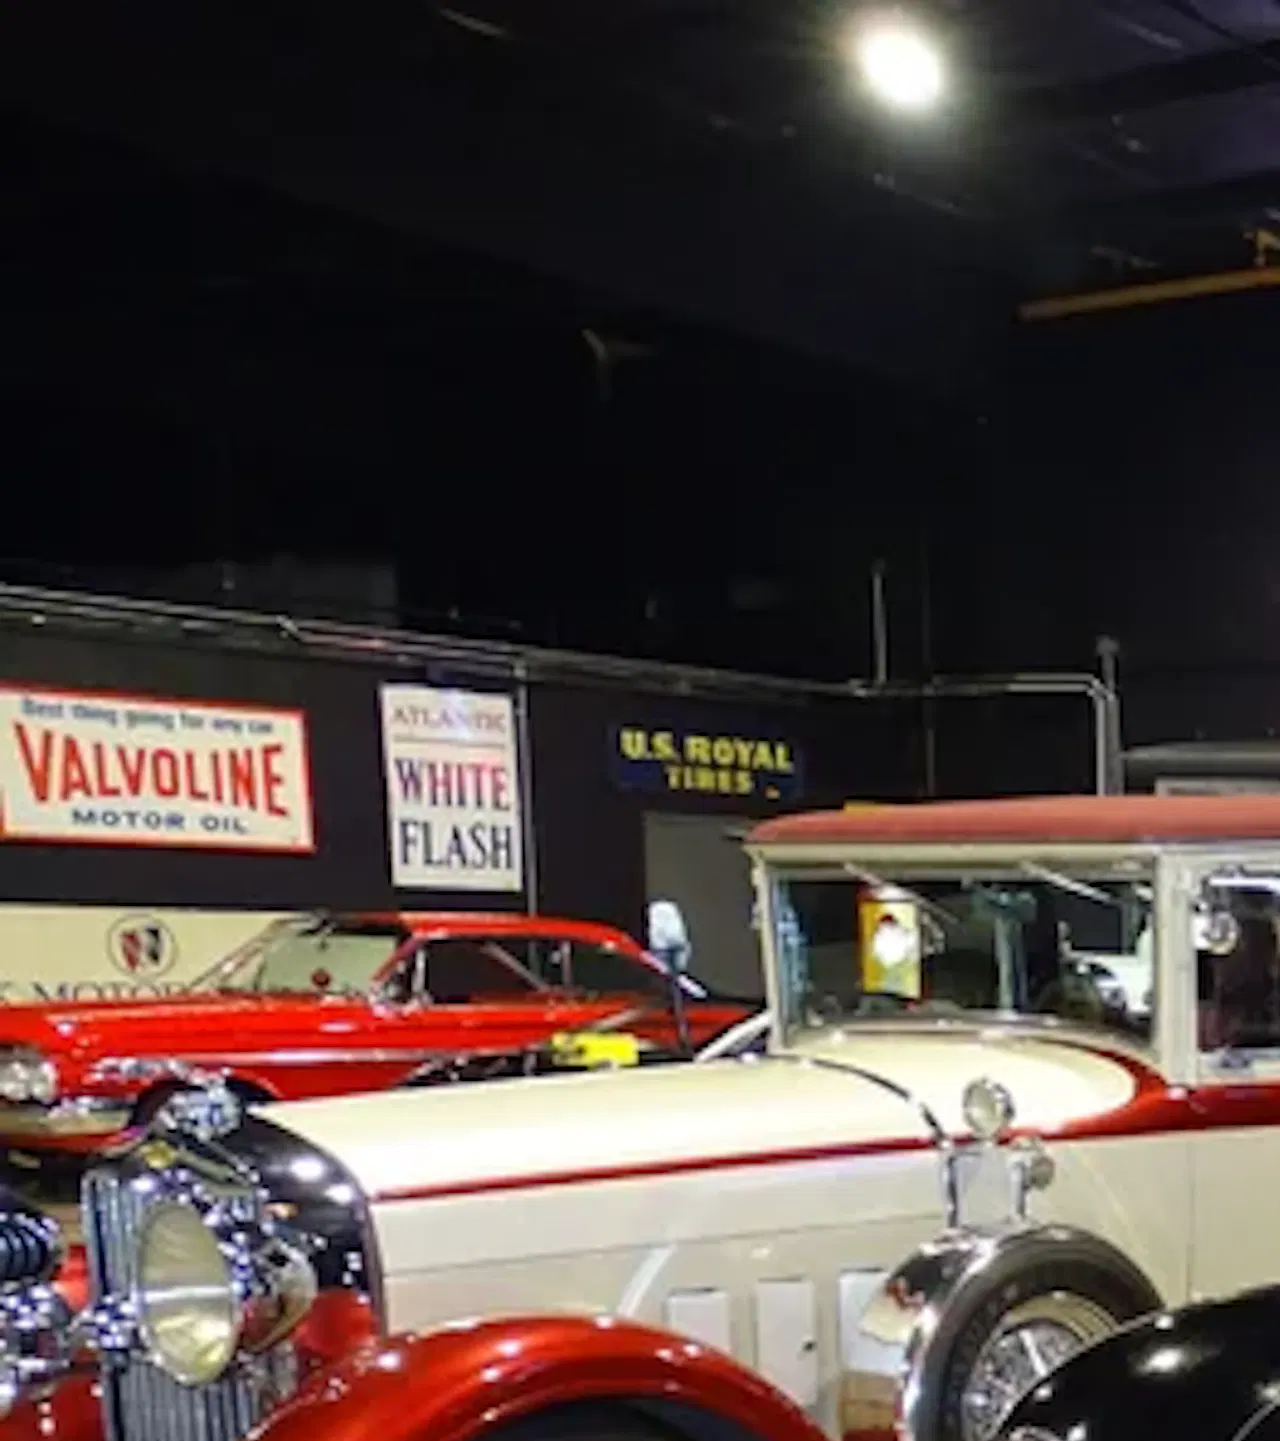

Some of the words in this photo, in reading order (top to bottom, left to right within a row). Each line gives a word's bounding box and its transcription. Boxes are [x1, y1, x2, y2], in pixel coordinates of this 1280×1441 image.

[14, 720, 290, 818] VALVOLINE
[684, 734, 795, 774] ROYAL
[395, 757, 511, 812] WHITE
[665, 764, 756, 796] TIRES
[71, 807, 186, 829] MOTOR
[200, 812, 250, 834] OIL
[400, 816, 513, 870] FLASH
